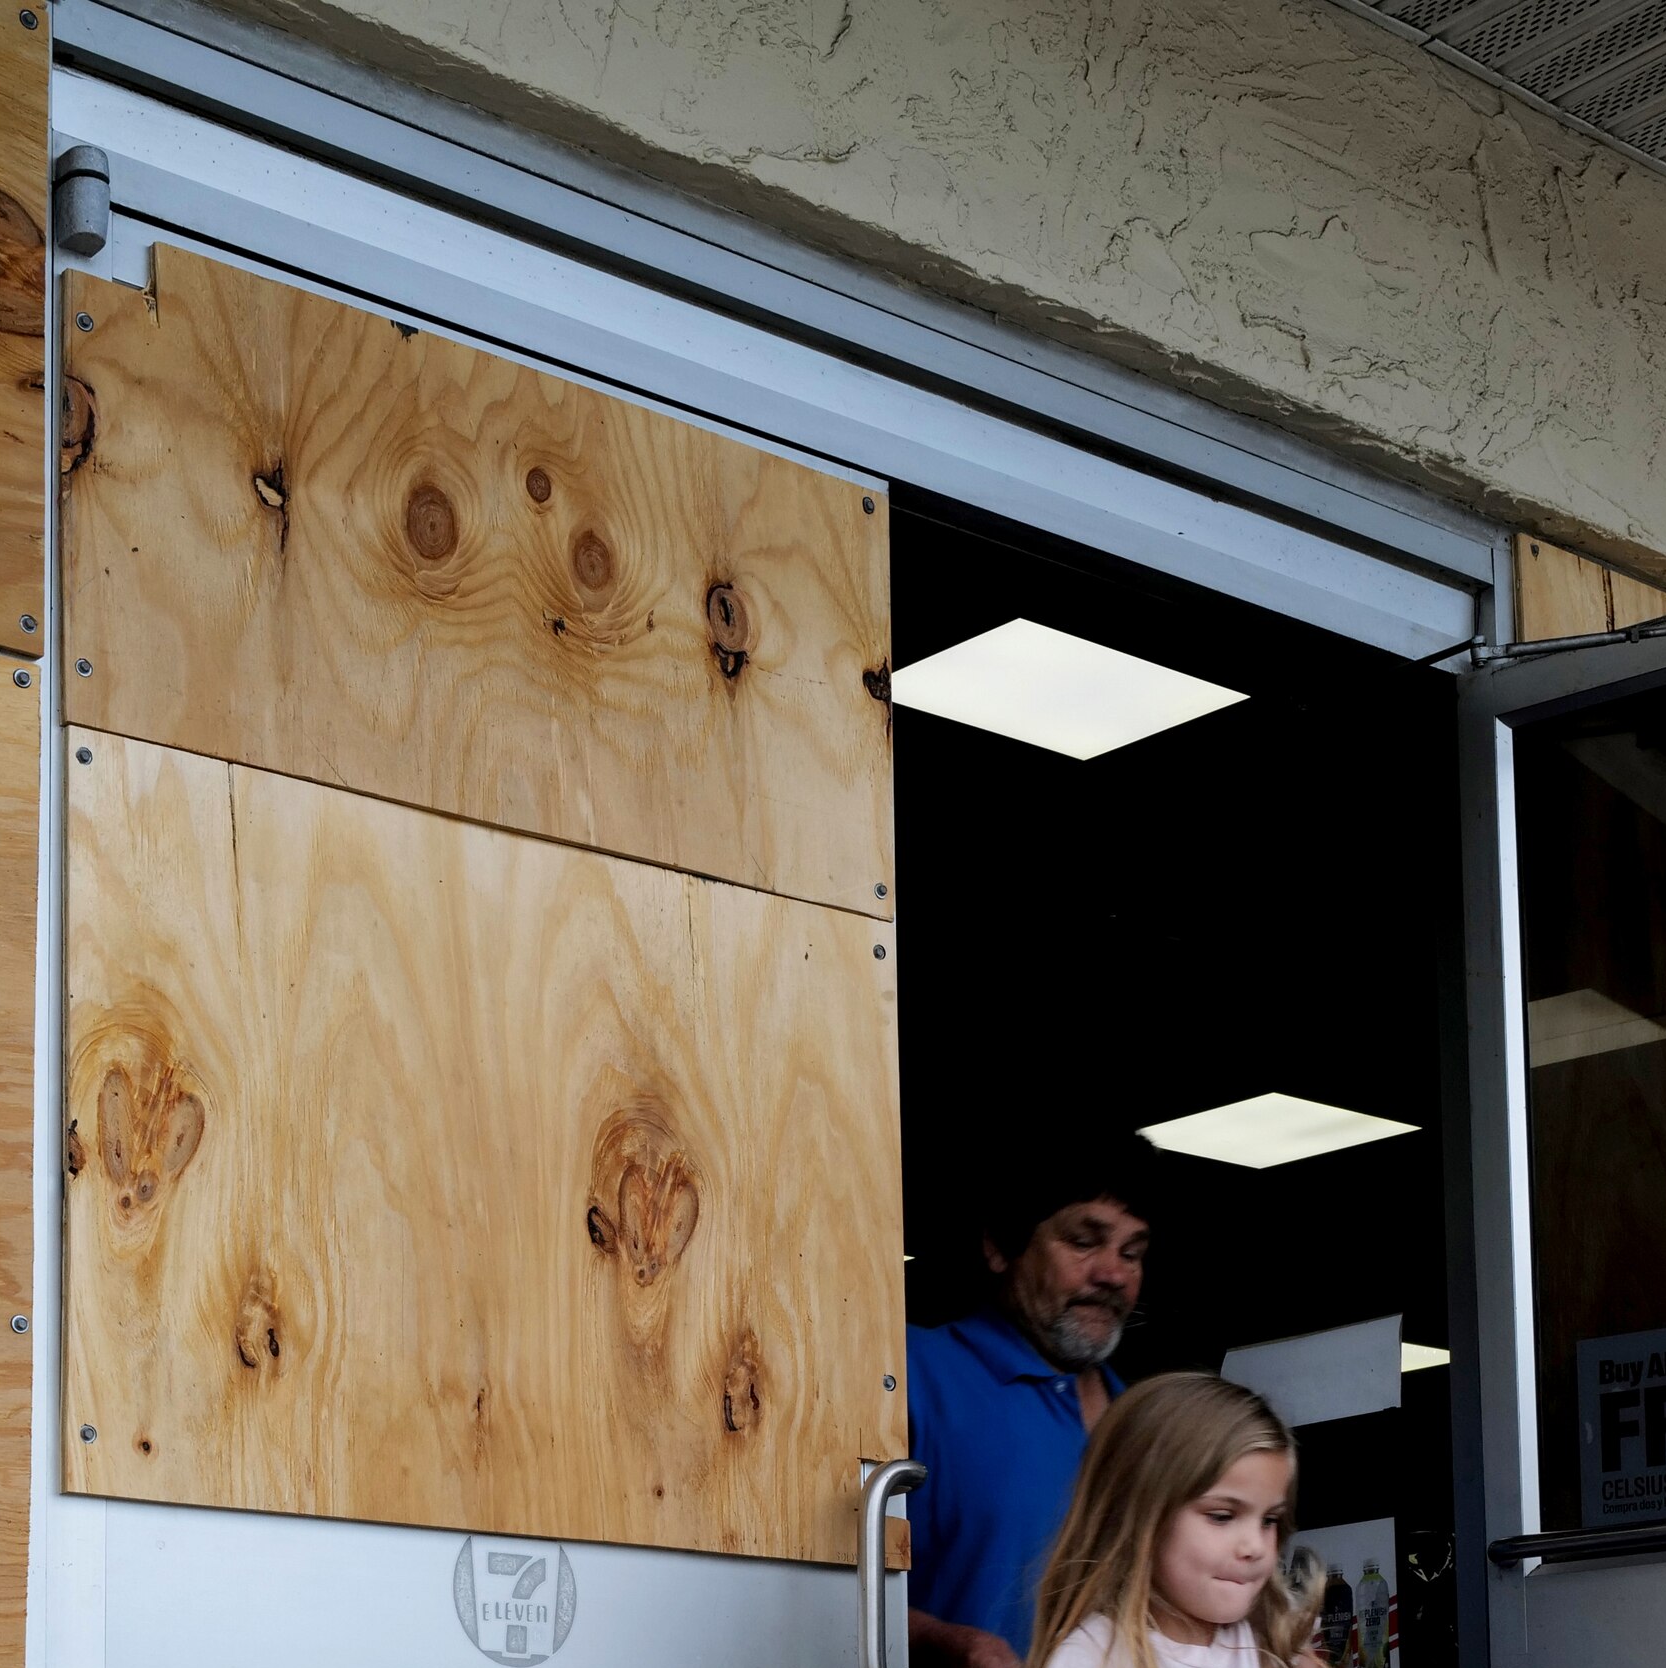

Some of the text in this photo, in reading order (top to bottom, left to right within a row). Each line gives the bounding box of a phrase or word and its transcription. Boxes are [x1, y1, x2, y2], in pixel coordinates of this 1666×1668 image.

[1599, 1359, 1643, 1387] Buy
[1602, 1501, 1638, 1515] Compra
[1640, 1498, 1656, 1510] dos
[1657, 1500, 1663, 1511] y
[488, 1551, 546, 1654] 7
